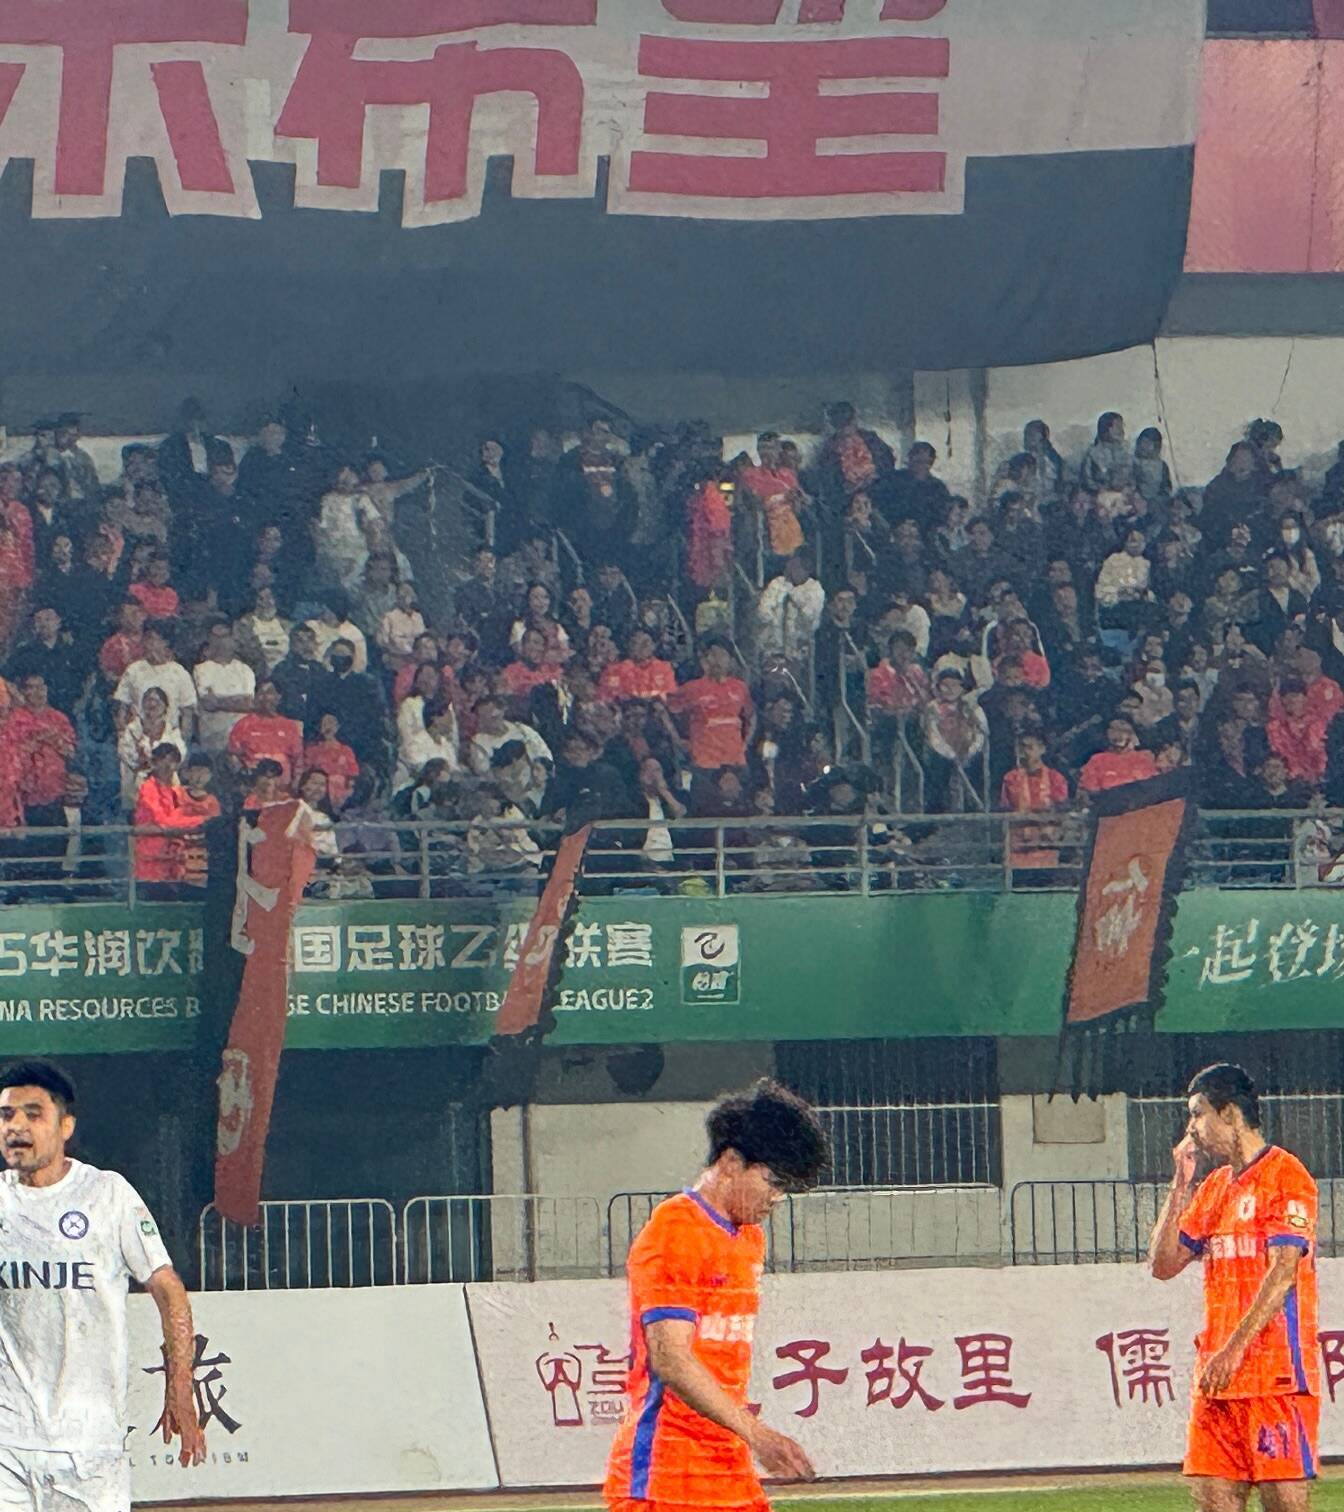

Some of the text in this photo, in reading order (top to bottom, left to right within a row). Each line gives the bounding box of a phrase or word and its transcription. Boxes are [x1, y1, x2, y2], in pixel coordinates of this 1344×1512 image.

[39, 997, 178, 1021] RESOURCES
[315, 992, 414, 1015] CHINESE
[419, 989, 510, 1012] FOOTB
[746, 1332, 1032, 1419] 子故里
